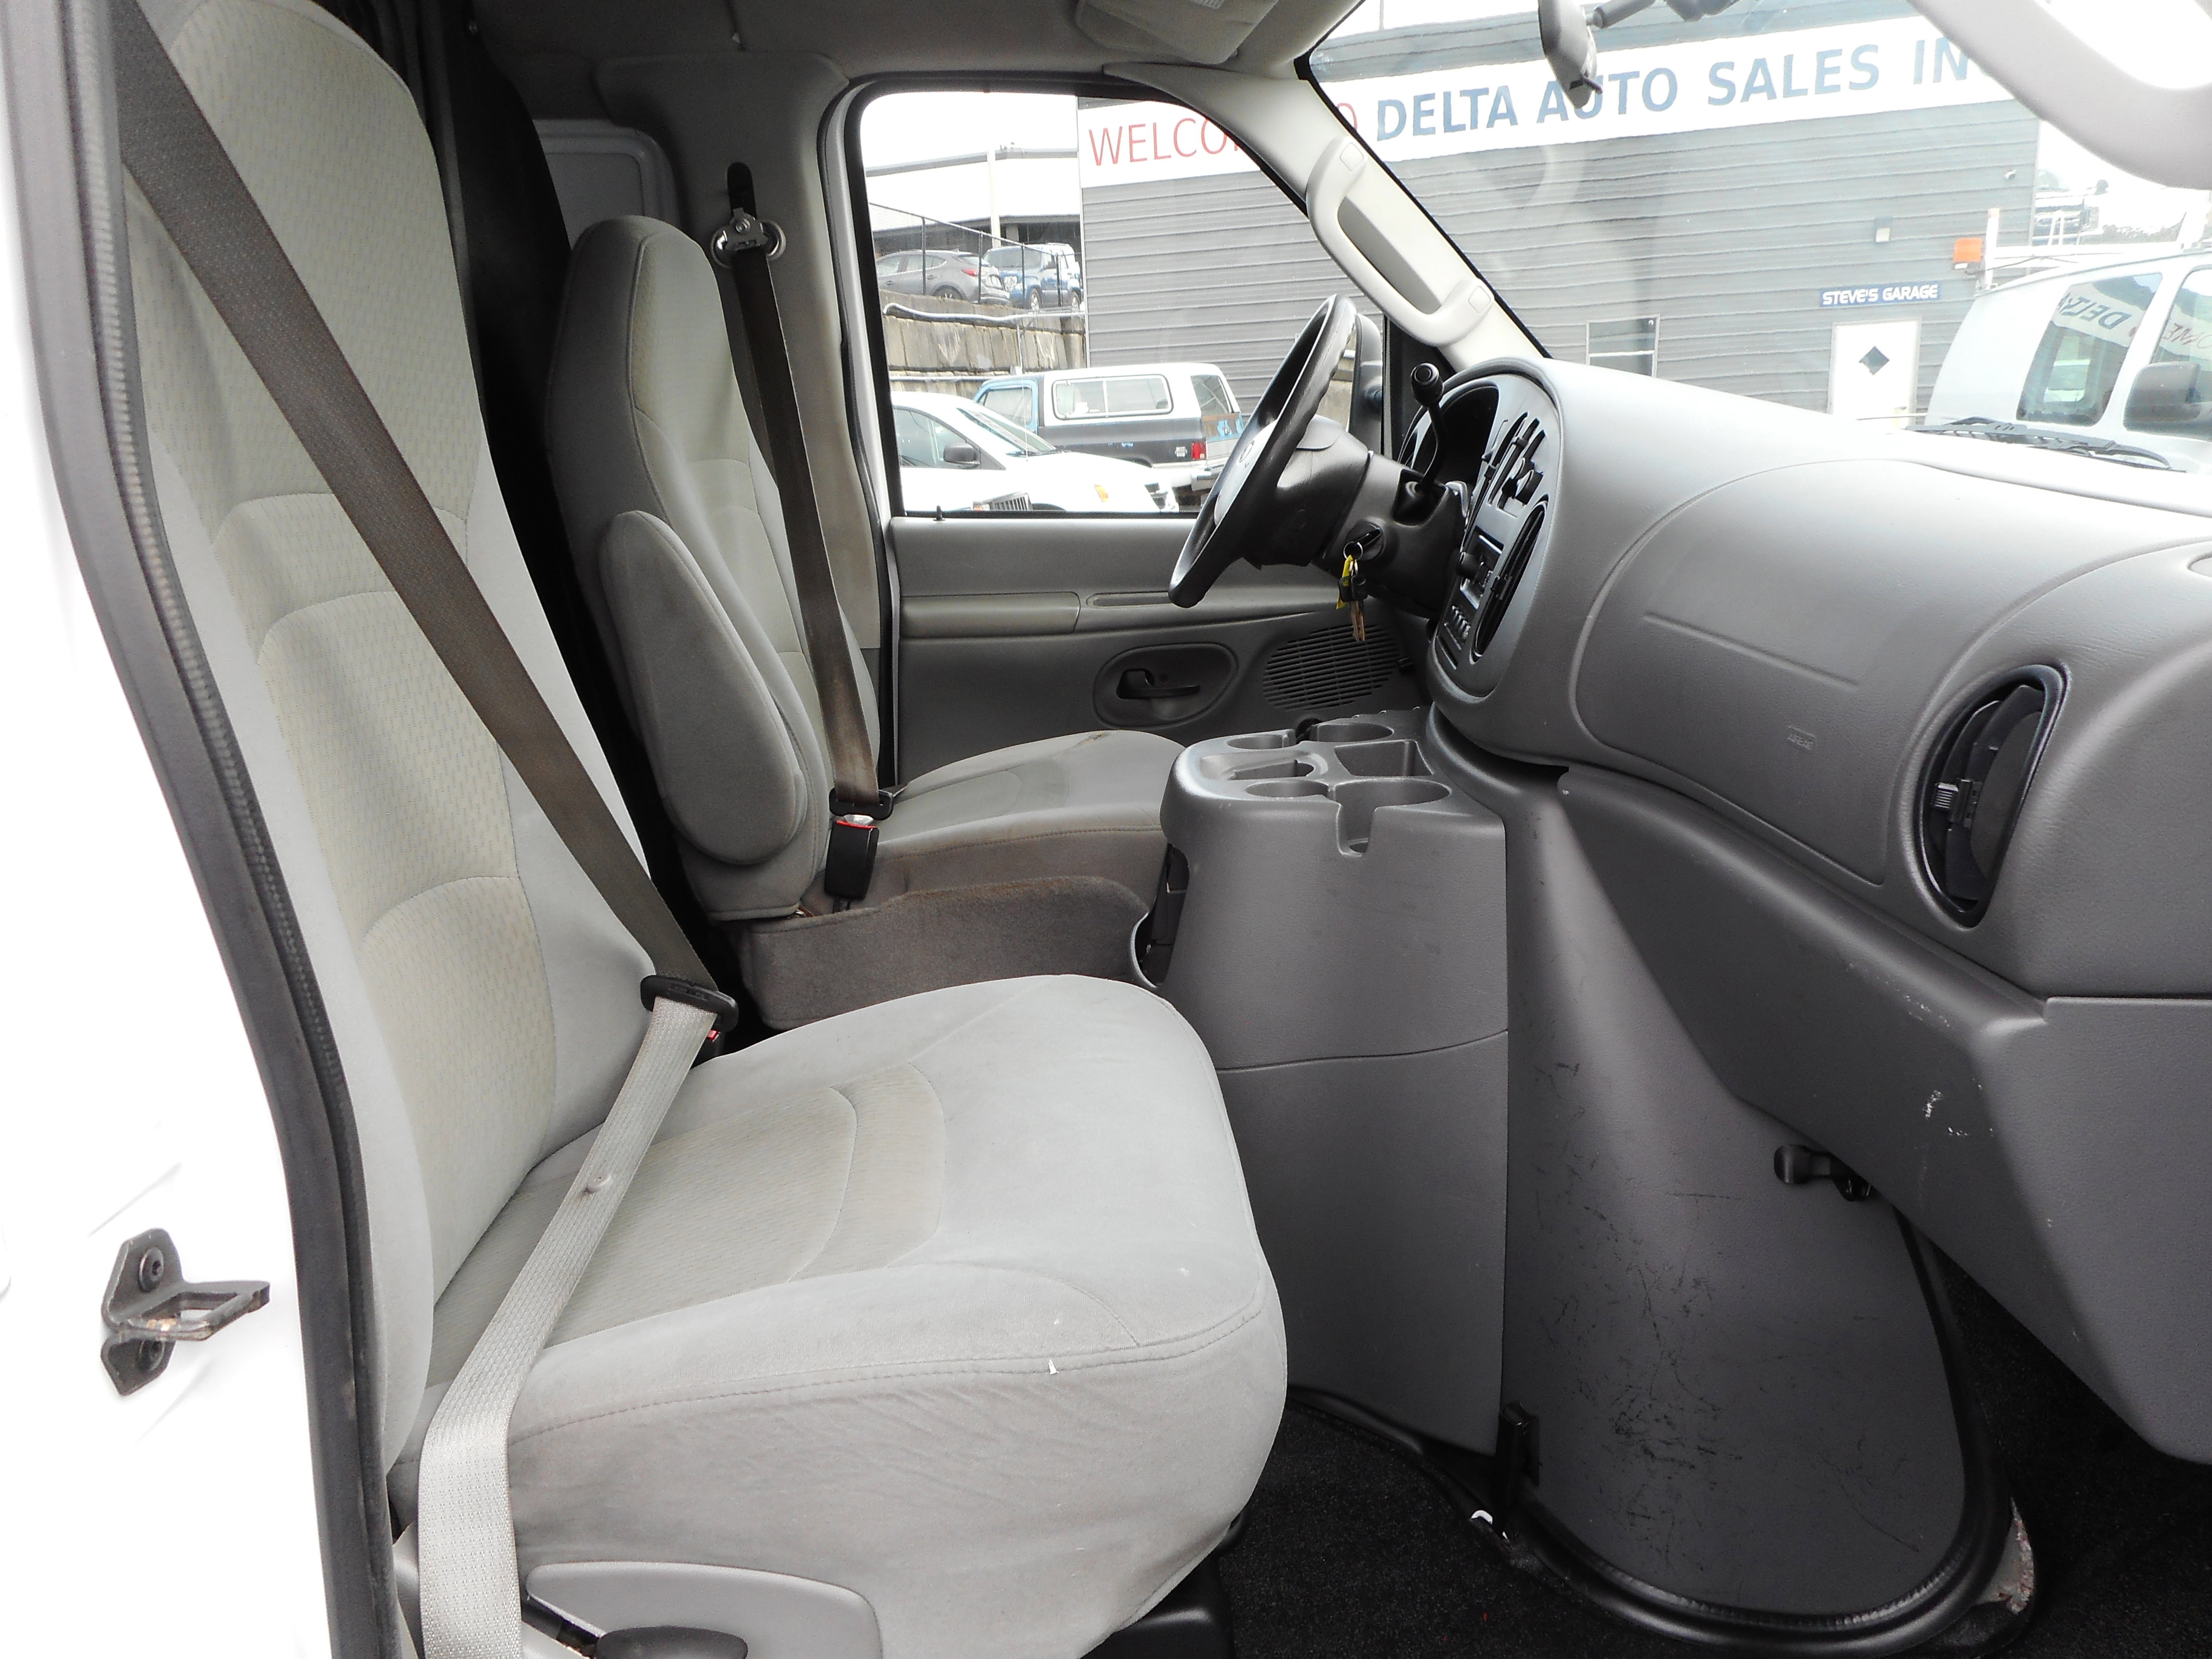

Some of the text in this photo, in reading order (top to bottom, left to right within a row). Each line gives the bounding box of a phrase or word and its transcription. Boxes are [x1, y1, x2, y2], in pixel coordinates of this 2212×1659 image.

[1089, 118, 1238, 166] WELCO
[1377, 85, 1518, 141] DELTA
[1537, 67, 1678, 124] AUTO
[1708, 44, 1879, 106] SALES
[1913, 37, 1992, 85] IN
[1823, 284, 1938, 305] STEVE'S GARAGE
